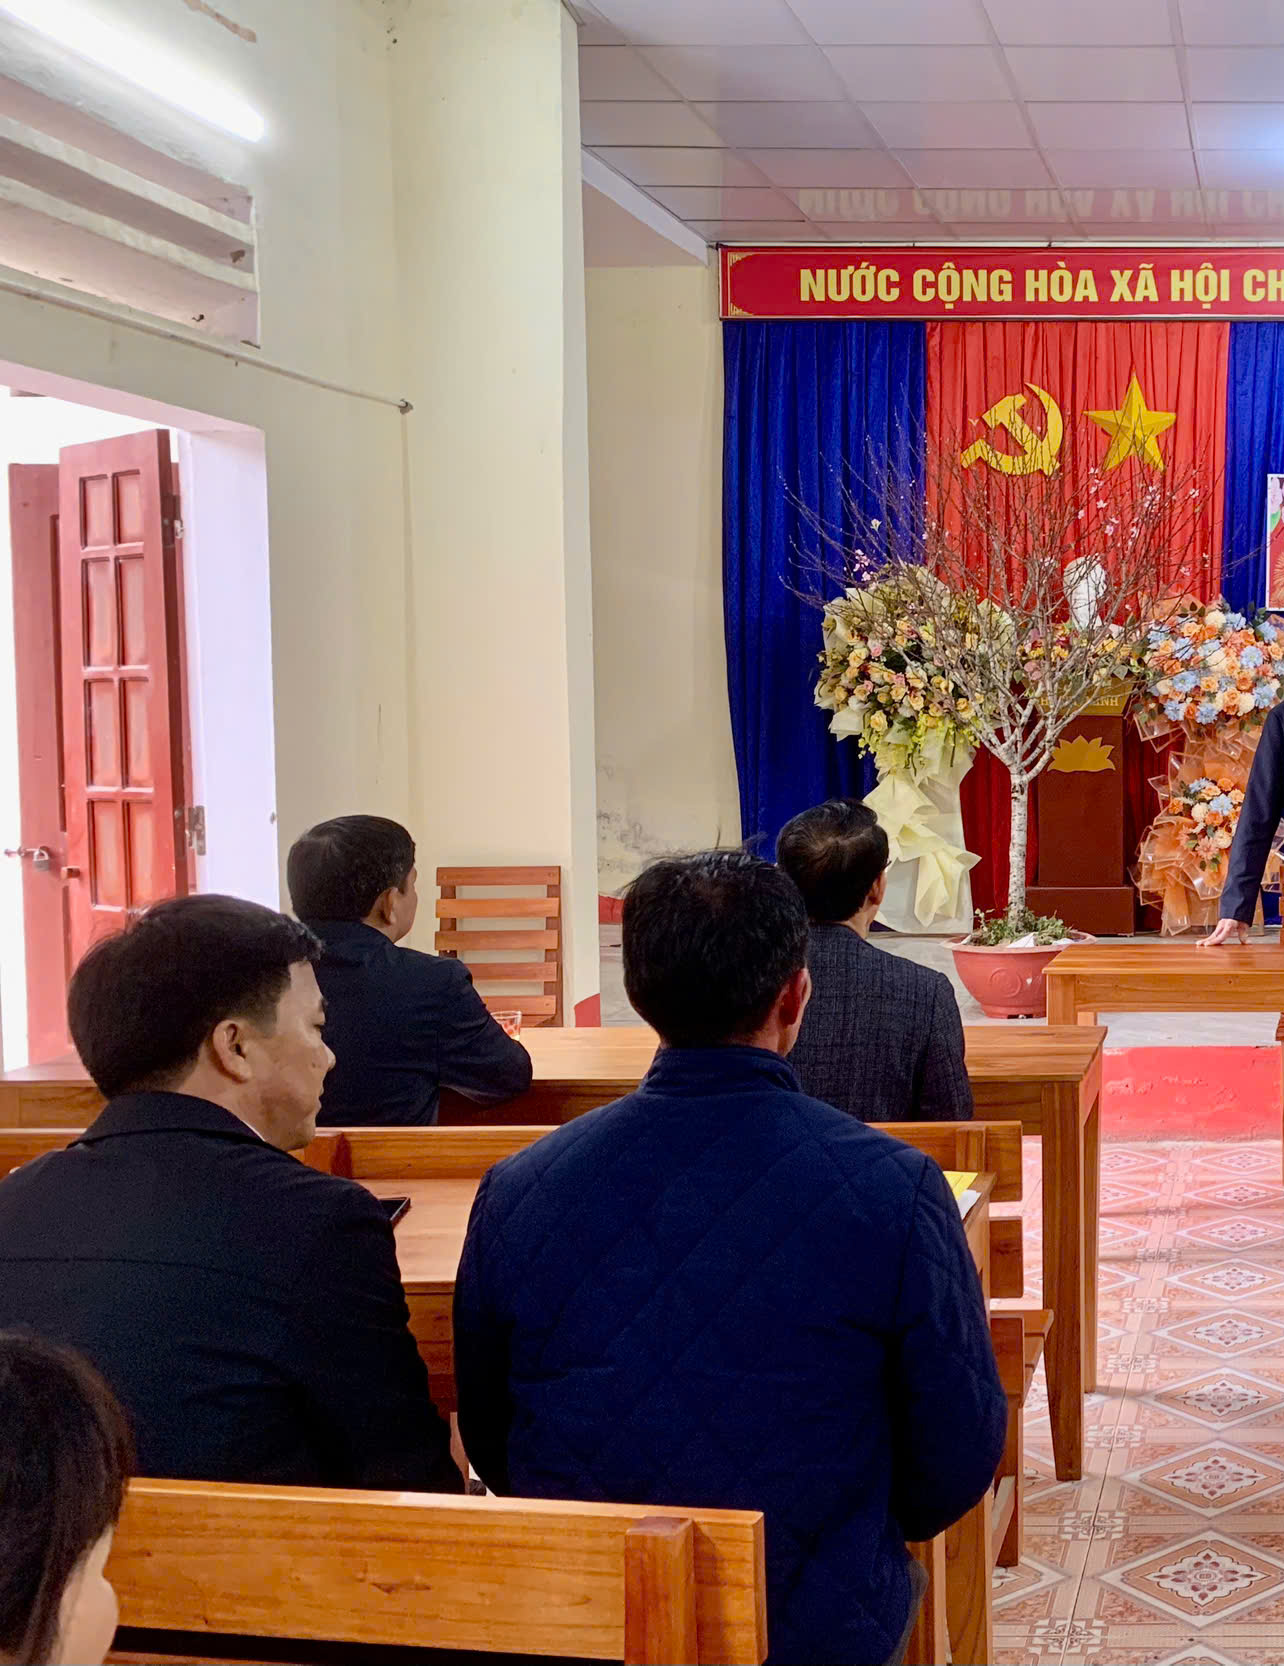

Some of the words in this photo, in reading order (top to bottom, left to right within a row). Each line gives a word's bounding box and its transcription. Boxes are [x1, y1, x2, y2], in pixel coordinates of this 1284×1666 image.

[800, 261, 900, 302] NƯỚC
[913, 261, 1012, 309] CỘNG
[1025, 261, 1099, 303] HÒA
[1110, 263, 1159, 302] XÃ
[1170, 262, 1230, 309] HỘI
